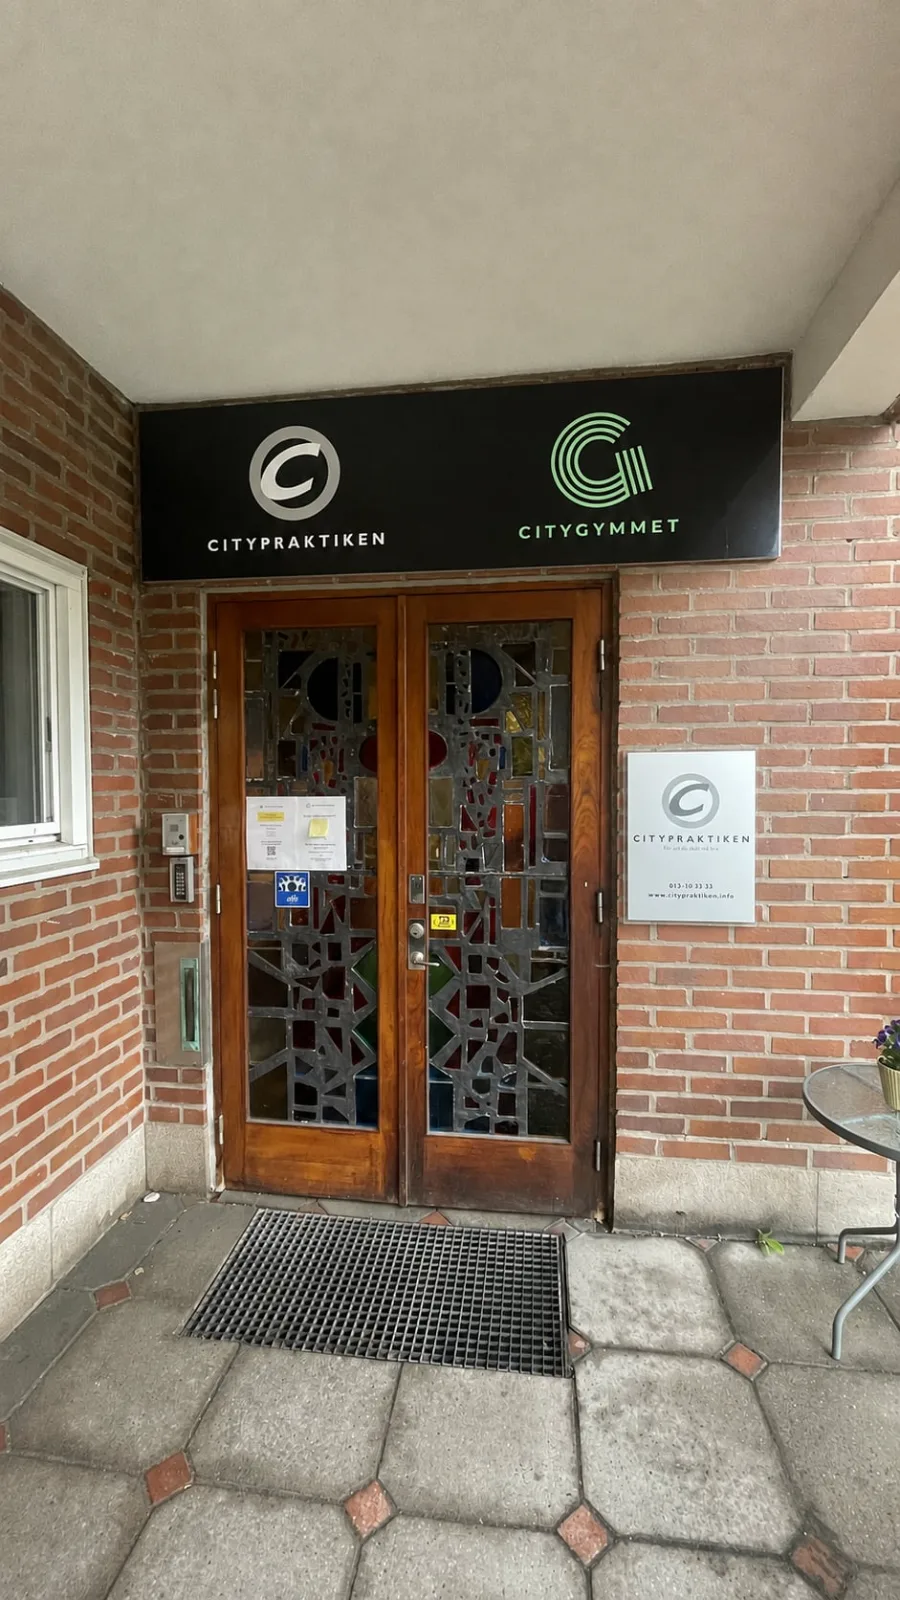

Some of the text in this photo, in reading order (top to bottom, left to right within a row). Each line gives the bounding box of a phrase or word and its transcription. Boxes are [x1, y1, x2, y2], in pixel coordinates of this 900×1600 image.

[518, 518, 680, 539] CITYGYMMET
[207, 532, 386, 552] CITYPRAKTIKEN
[633, 834, 750, 843] CITYPRAKTIKEN
